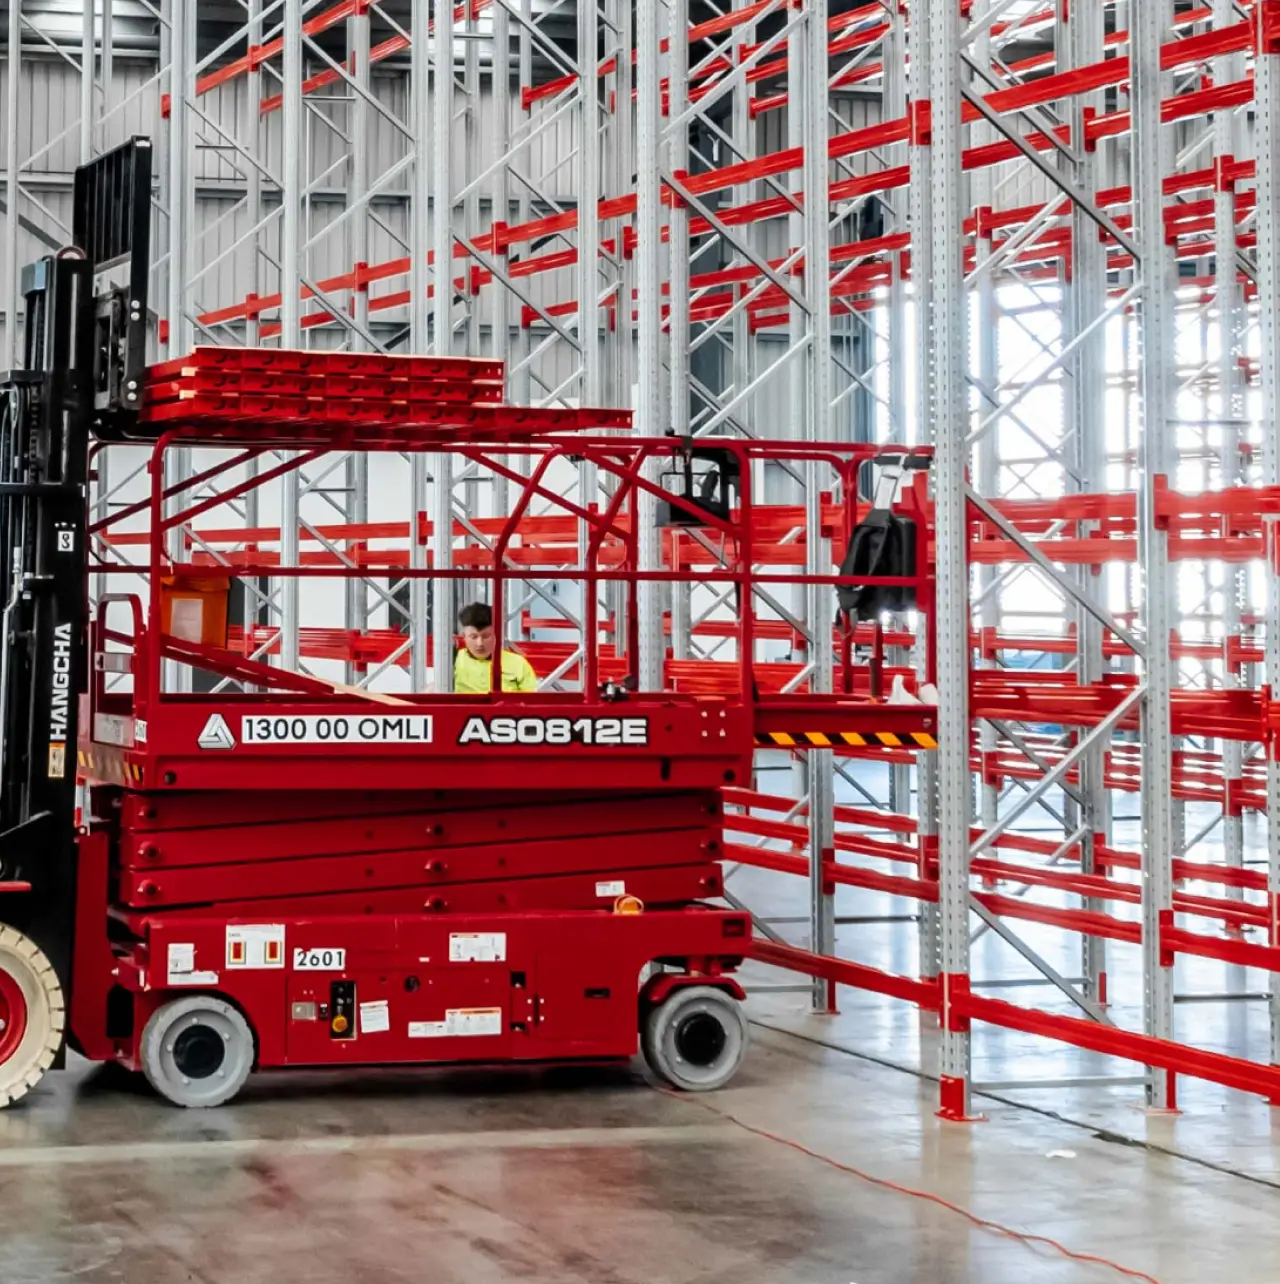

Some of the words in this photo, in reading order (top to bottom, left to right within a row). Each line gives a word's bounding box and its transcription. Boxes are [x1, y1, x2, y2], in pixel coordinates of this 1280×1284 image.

[49, 622, 72, 740] HANGCHA
[245, 718, 307, 741] 1300
[315, 718, 349, 740] 00
[358, 718, 429, 740] OMLI
[457, 717, 648, 744] AS0812E
[297, 950, 343, 967] 2601
